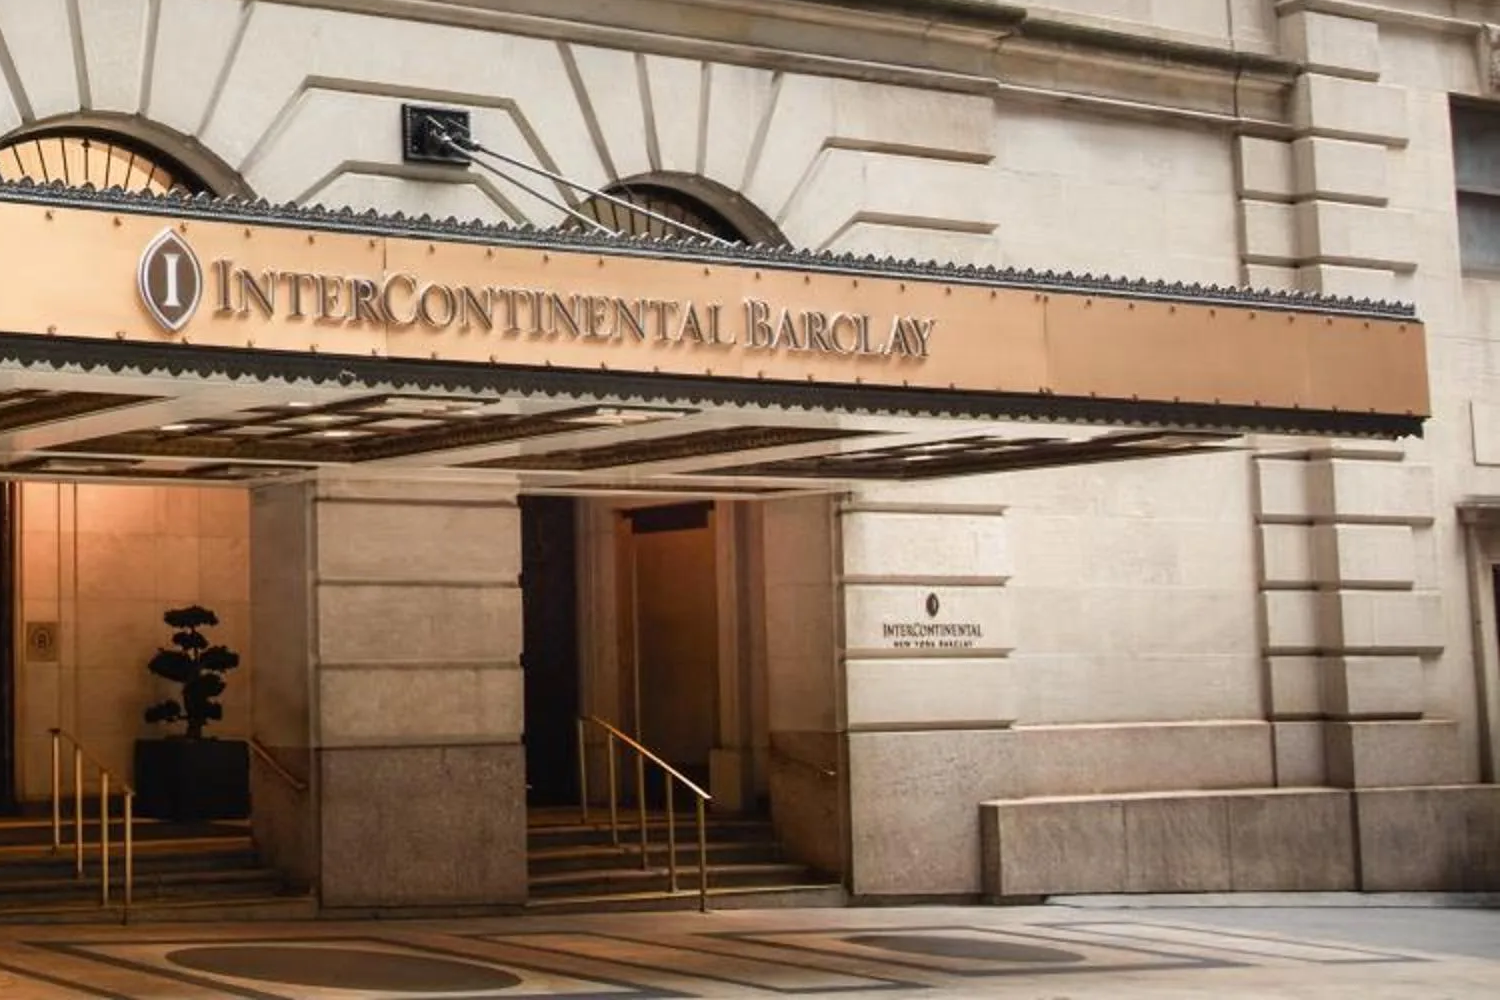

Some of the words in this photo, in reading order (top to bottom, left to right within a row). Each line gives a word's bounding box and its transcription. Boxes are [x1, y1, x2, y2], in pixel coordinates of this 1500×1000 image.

[212, 256, 737, 346] INTERCONTINENTAL
[743, 296, 935, 357] BARCLAY
[883, 622, 983, 639] INTERCONTINENTAL
